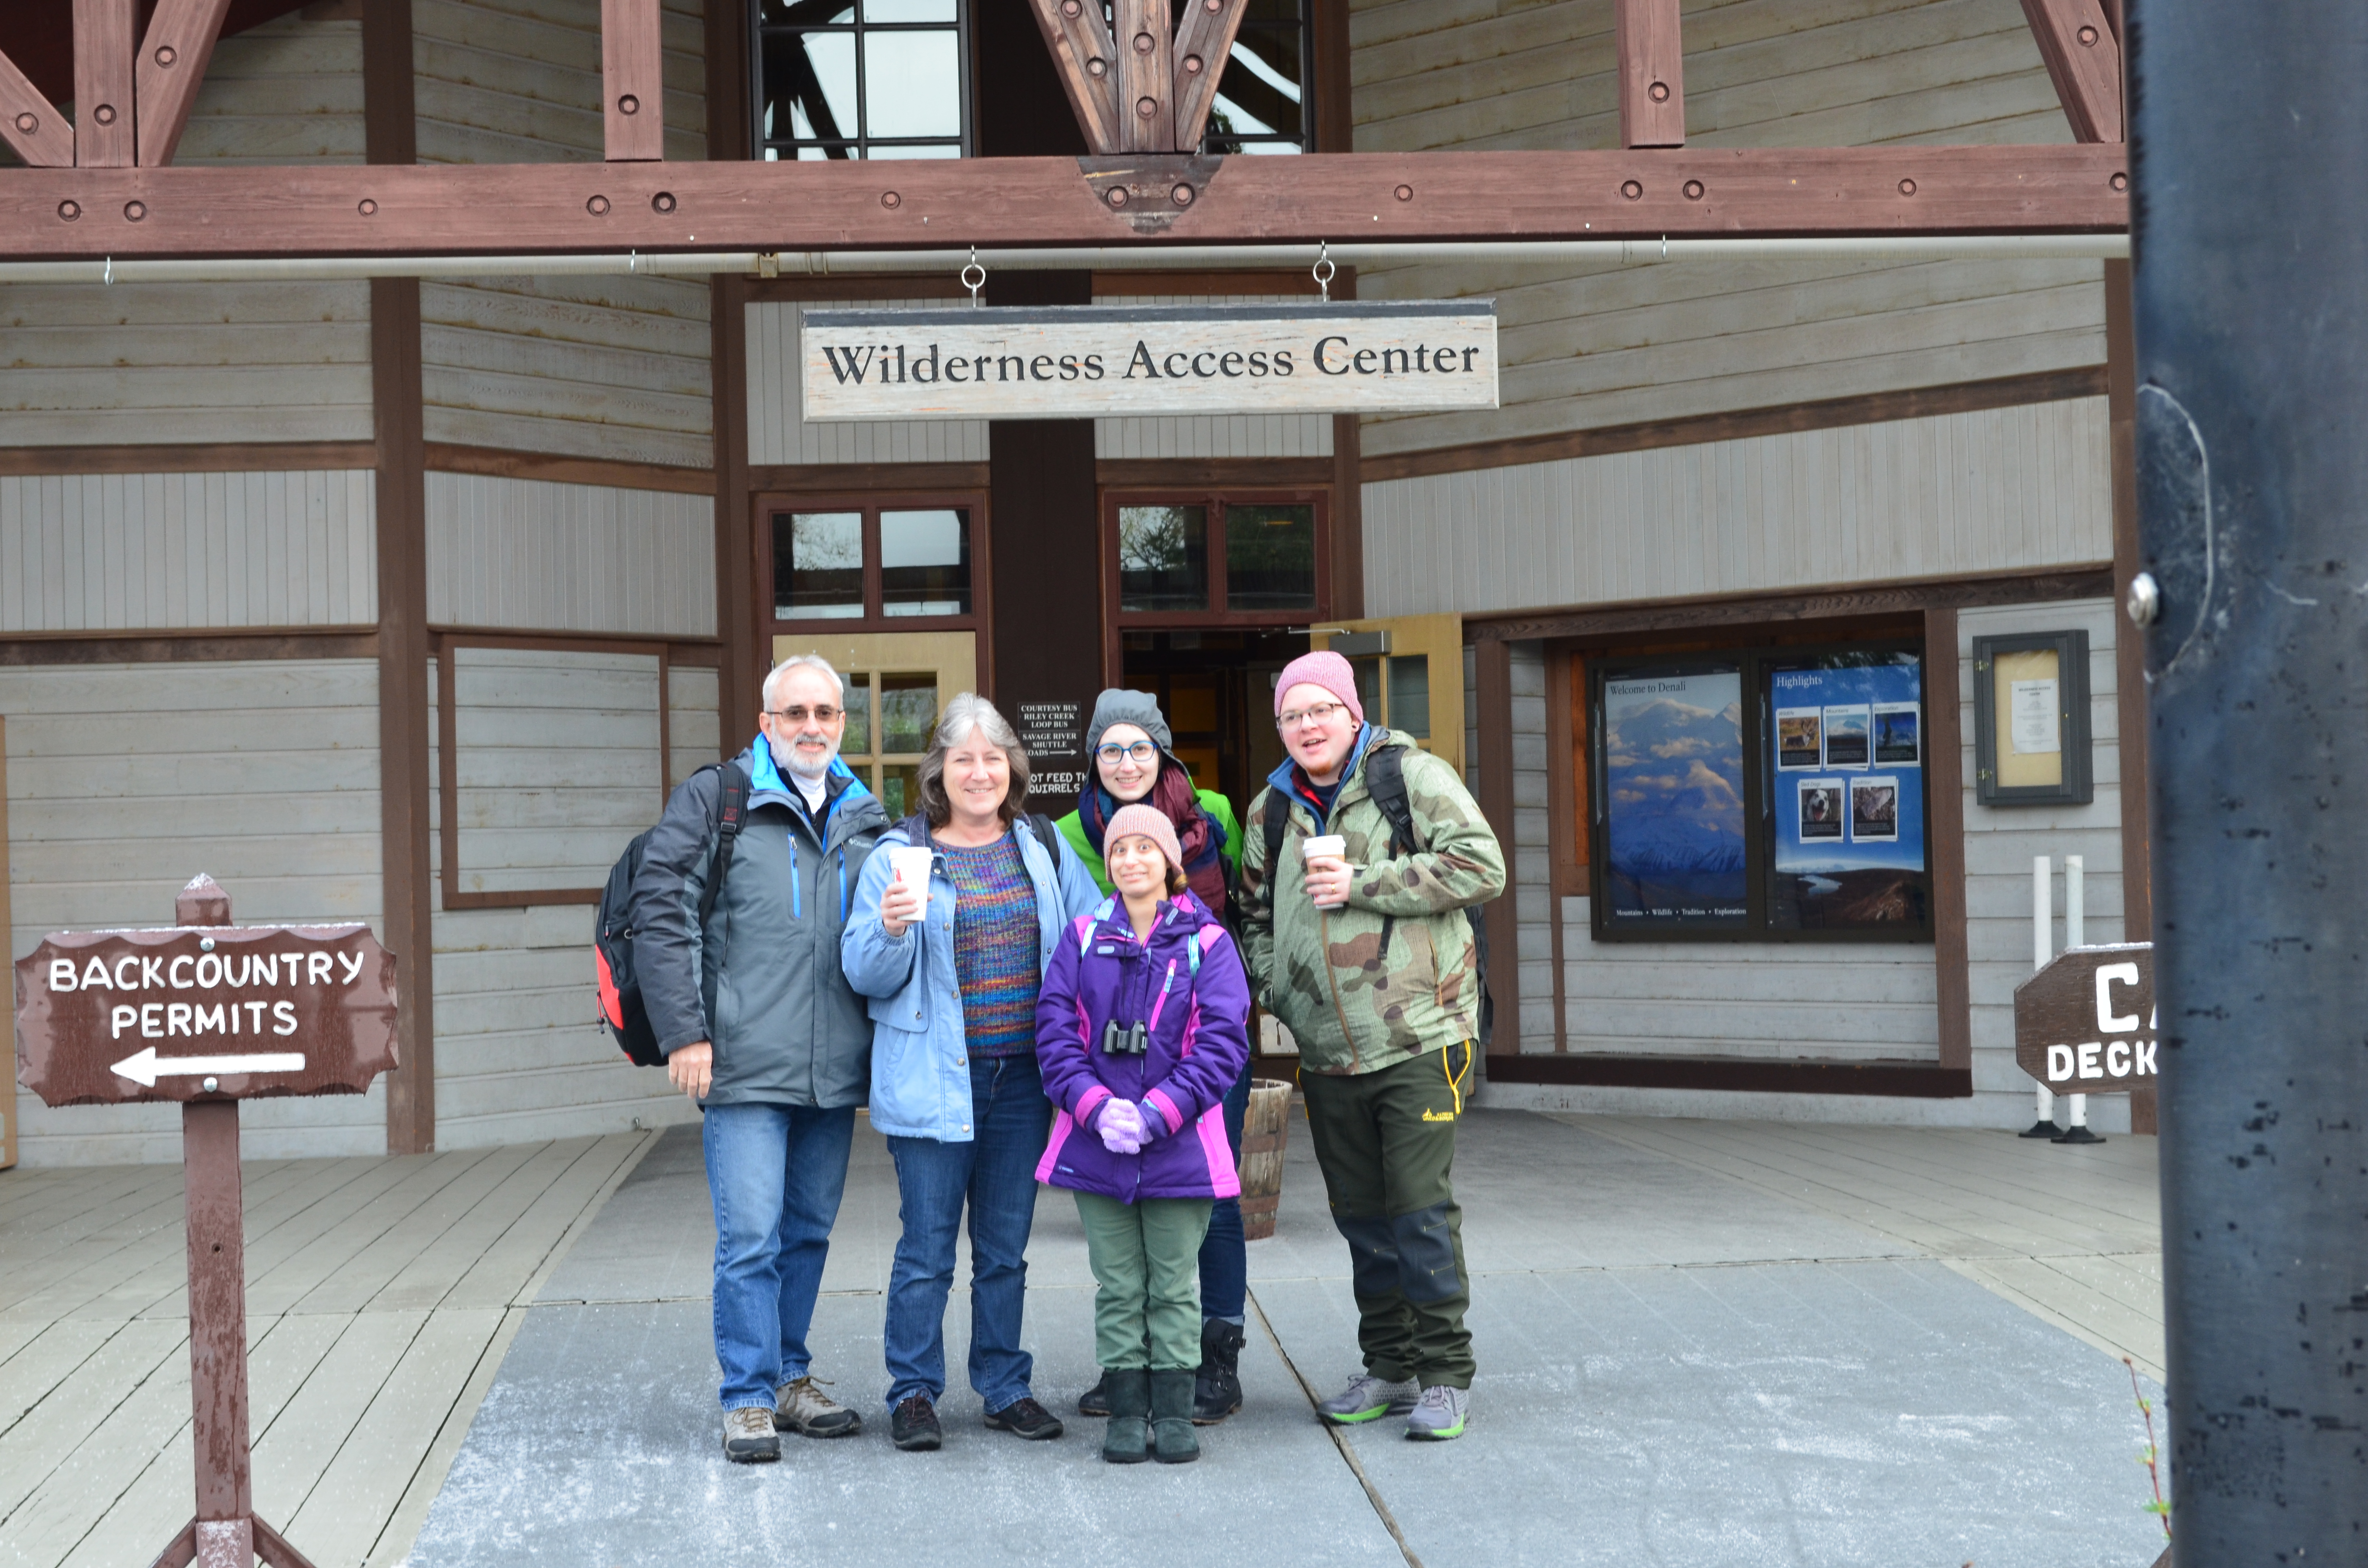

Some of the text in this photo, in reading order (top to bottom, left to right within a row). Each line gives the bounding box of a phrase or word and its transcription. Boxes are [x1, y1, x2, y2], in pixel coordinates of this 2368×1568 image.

[822, 336, 1479, 385] Wilderness Access Center
[1611, 681, 1686, 695] Welcome to Denali
[1777, 674, 1823, 689] Highlights
[1030, 772, 1086, 784] OT FEED TH
[1029, 783, 1080, 794] QUIRRELS
[853, 839, 873, 849] Columbi
[1714, 908, 1746, 917] Exploration
[50, 950, 364, 992] BACKCOUNTRY
[111, 1001, 298, 1039] PERMITS
